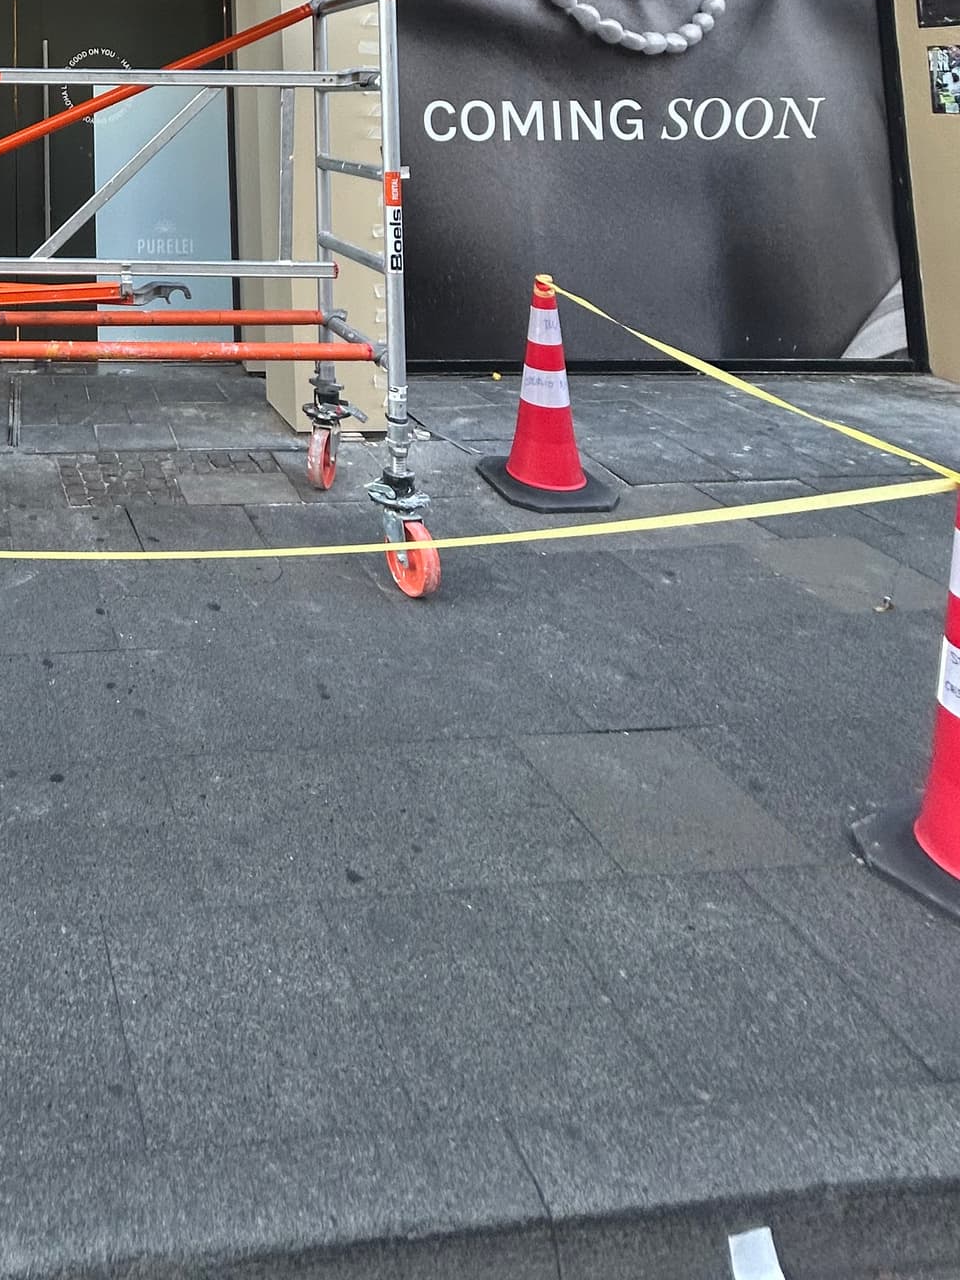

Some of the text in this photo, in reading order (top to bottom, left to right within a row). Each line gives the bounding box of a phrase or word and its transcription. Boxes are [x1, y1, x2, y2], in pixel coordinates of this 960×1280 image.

[69, 51, 87, 67] GOOD
[101, 48, 116, 58] YOU
[422, 97, 826, 142] COMING SOON
[137, 239, 193, 255] PURELEI
[388, 208, 403, 271] Boels
